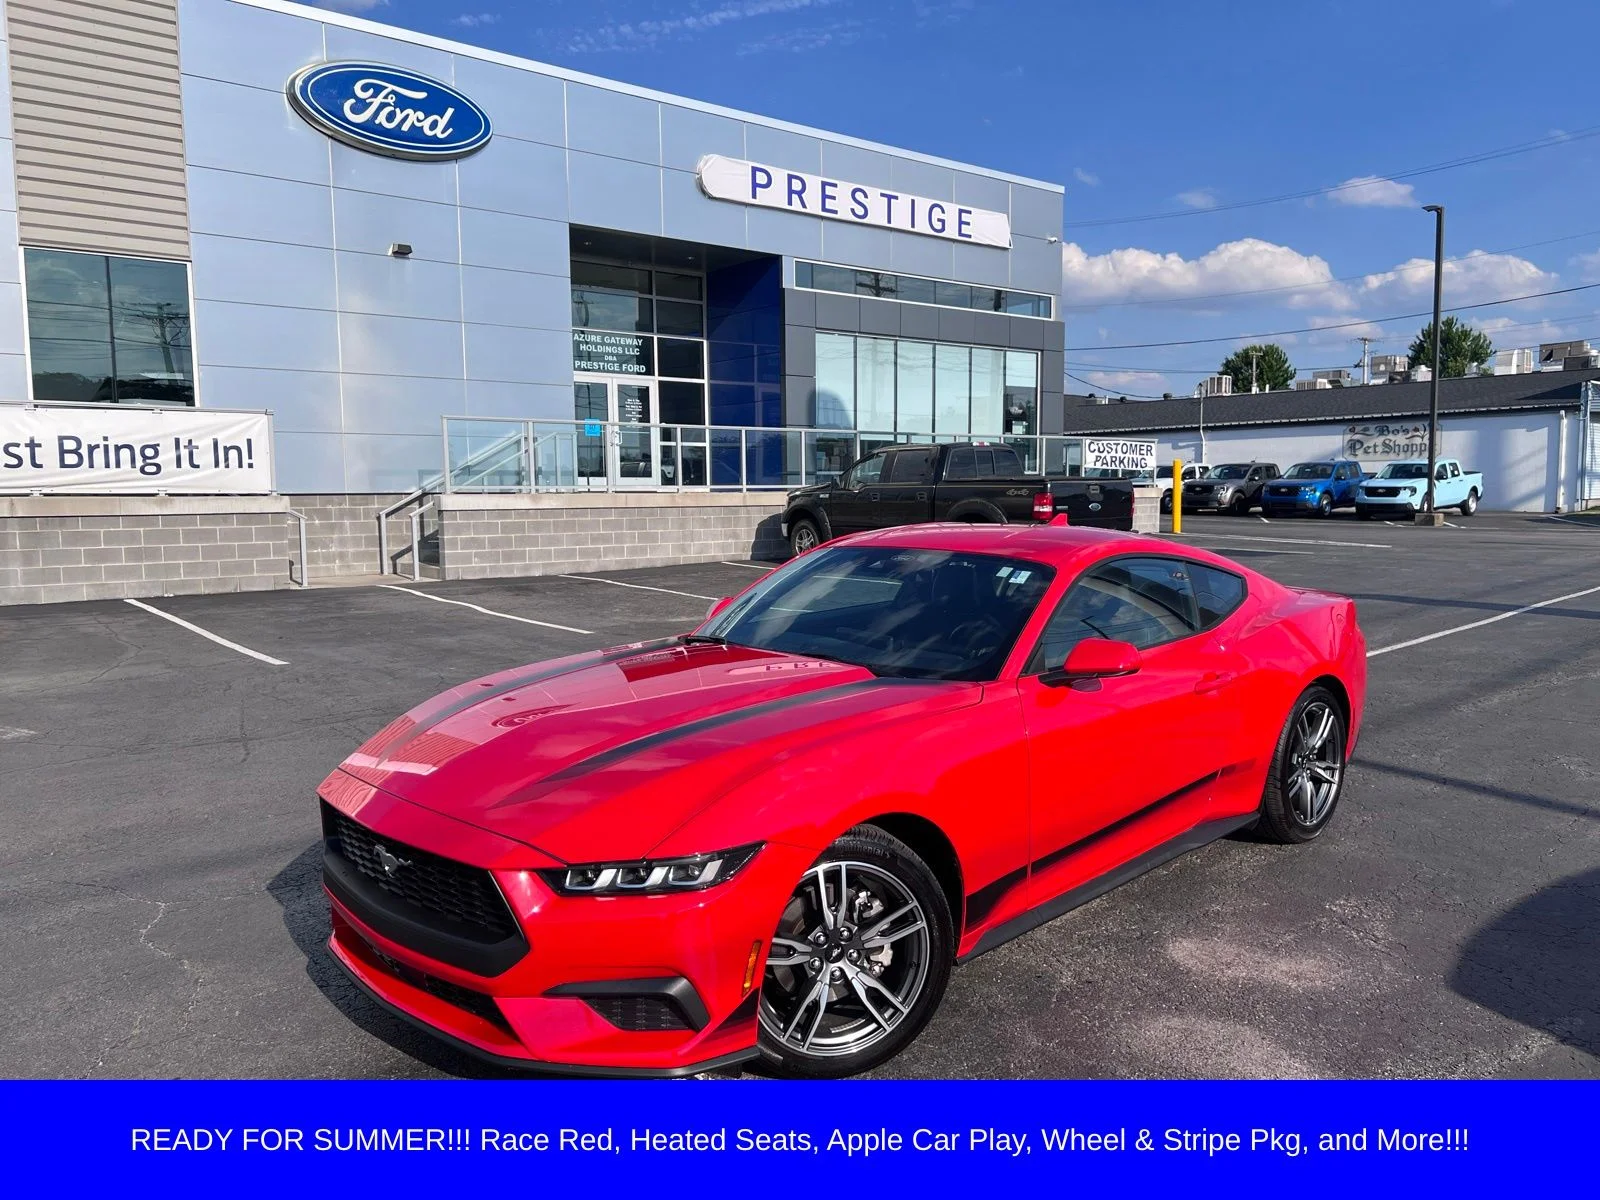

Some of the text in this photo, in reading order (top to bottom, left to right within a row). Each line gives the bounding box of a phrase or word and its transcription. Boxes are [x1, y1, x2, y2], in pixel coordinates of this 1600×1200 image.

[343, 79, 455, 139] Ford
[750, 165, 973, 239] PRESTIGE
[573, 333, 643, 346] AZURE GATEWAY
[580, 344, 640, 356] HOLDINGS LLC
[574, 360, 646, 373] PRESTIGE FORD
[1375, 425, 1410, 437] Bo's
[3, 435, 254, 475] st Bring It In!
[1087, 441, 1153, 457] CUSTOMER
[1347, 438, 1428, 457] Pet Shopp
[1093, 455, 1148, 469] PARKING
